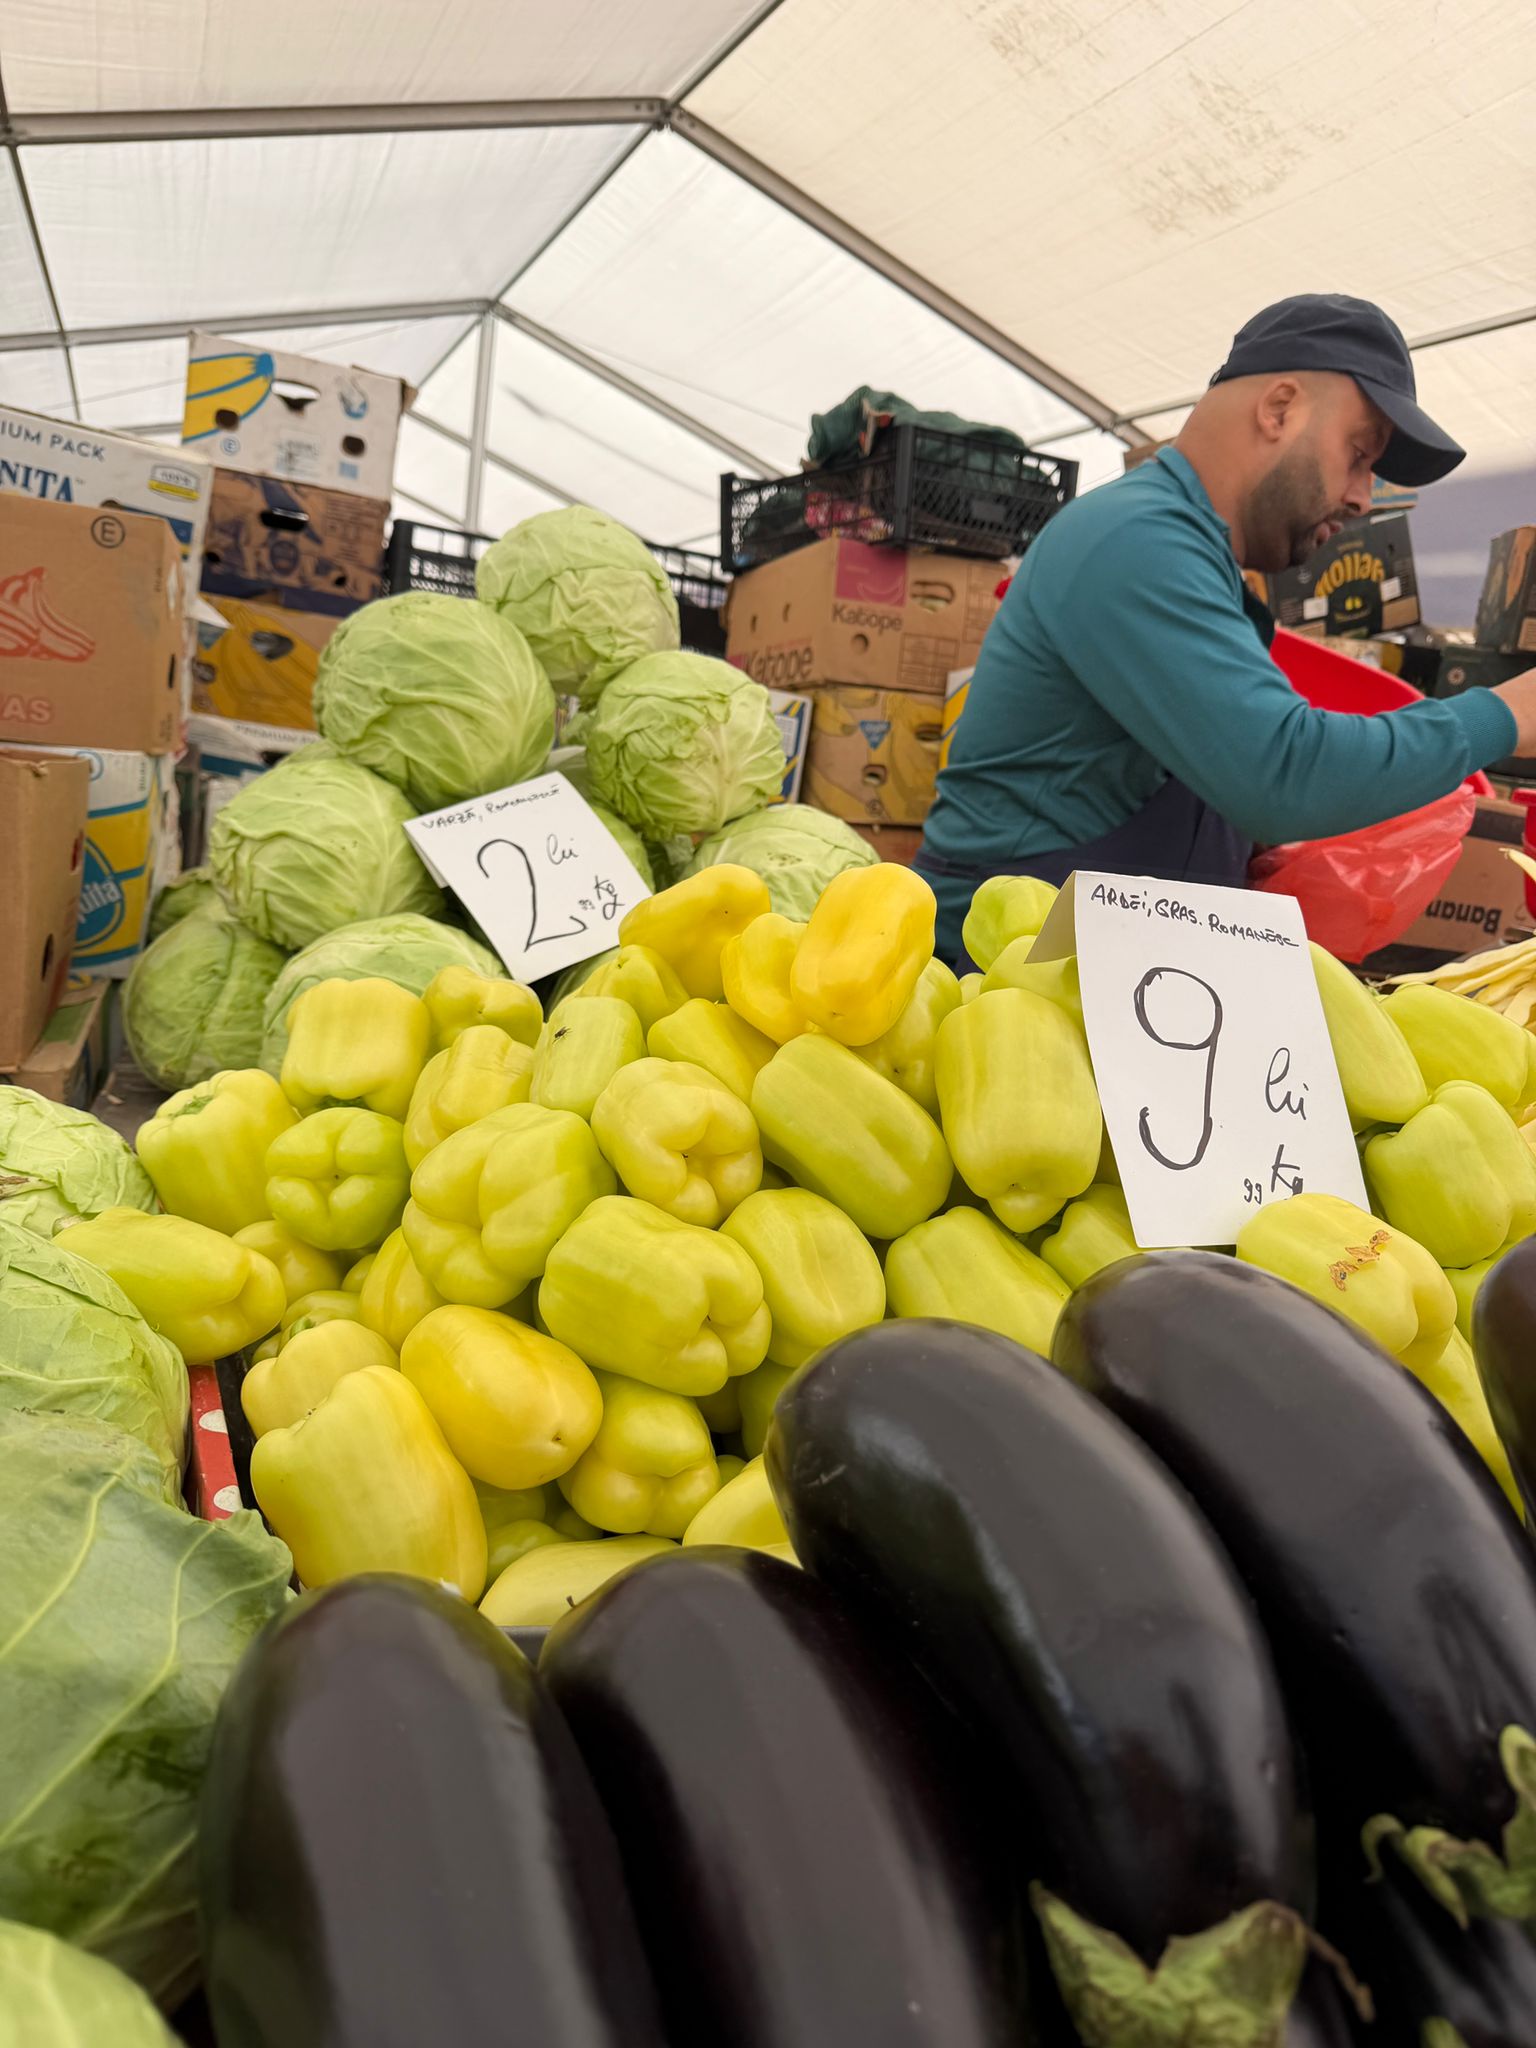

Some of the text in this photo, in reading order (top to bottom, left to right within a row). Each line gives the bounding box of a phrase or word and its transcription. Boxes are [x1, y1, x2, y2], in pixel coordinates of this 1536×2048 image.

[50, 433, 105, 461] PACK
[0, 458, 73, 503] NITA
[832, 603, 903, 636] Katope
[476, 838, 588, 953] 2
[1134, 966, 1223, 1171] 9
